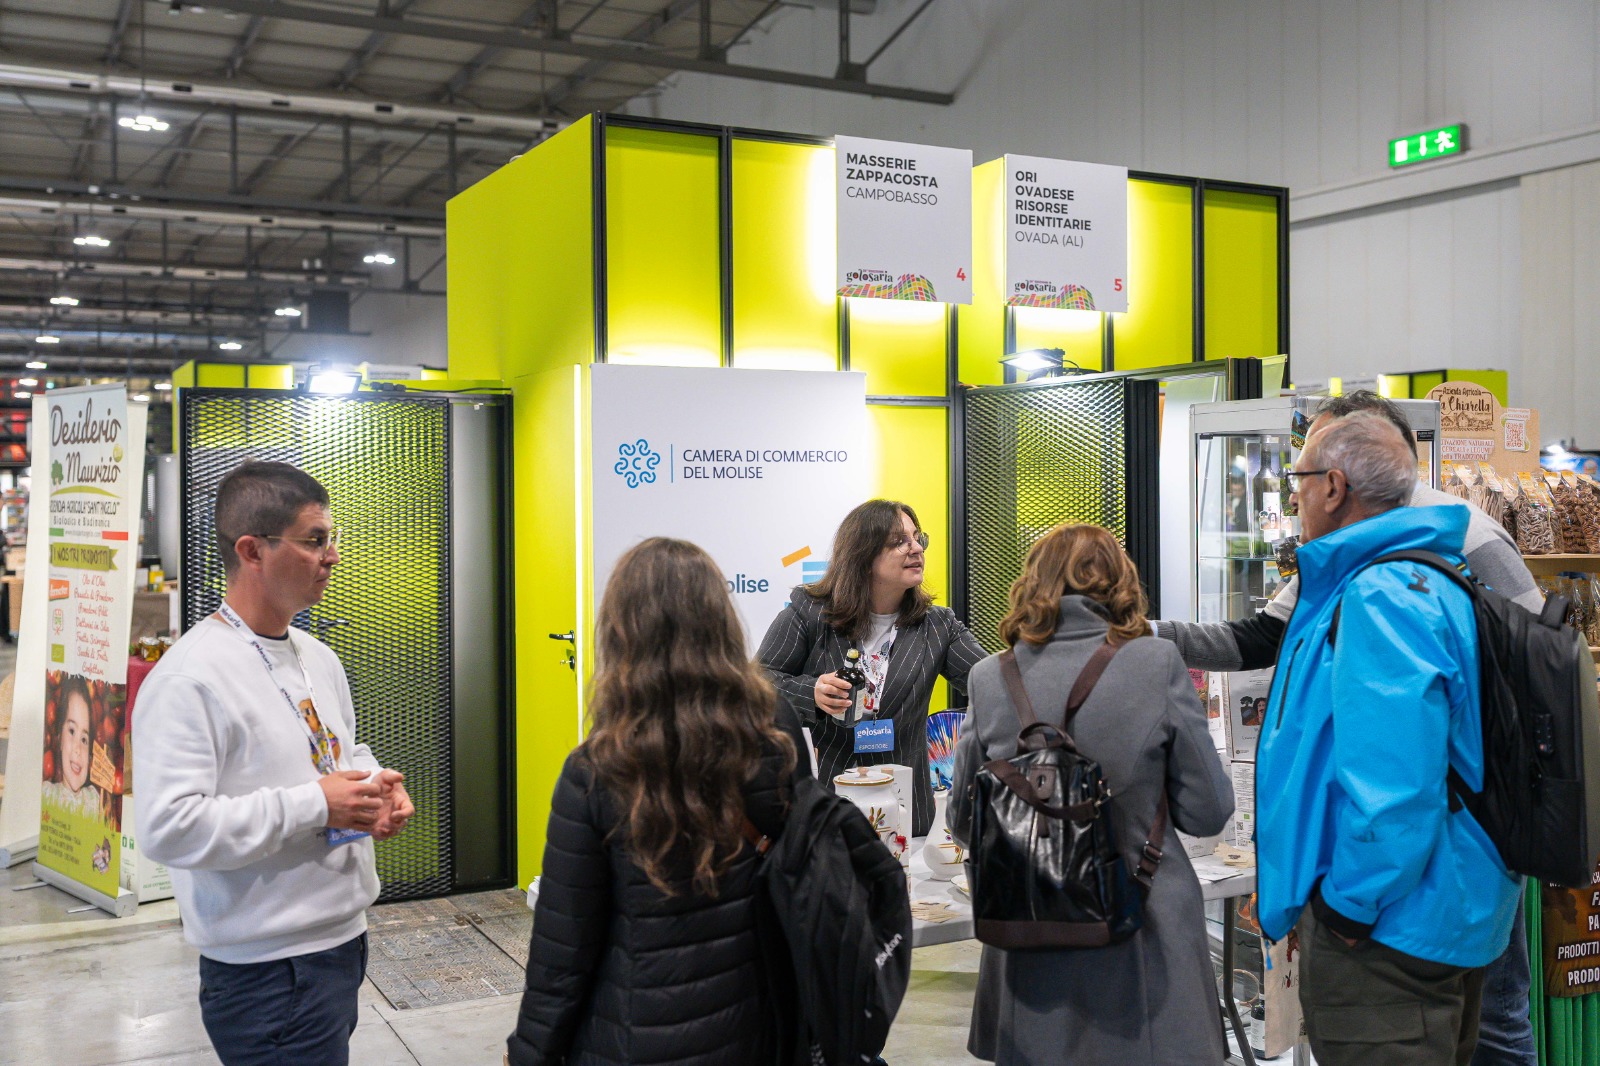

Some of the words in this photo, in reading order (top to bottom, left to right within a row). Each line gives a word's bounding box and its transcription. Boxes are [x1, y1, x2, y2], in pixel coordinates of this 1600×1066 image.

[846, 153, 916, 171] MASSERIE
[846, 168, 938, 189] ZAPPACOSTA
[1015, 170, 1037, 183] ORI
[846, 186, 938, 206] CAMPOBASSO
[1015, 185, 1074, 201] OVADESE
[1015, 200, 1068, 214] RISORSE
[1015, 214, 1091, 231] IDENTITARIE
[1015, 231, 1058, 245] OVADA
[1062, 234, 1084, 248] (AL)
[846, 268, 893, 282] golosaria
[956, 267, 967, 282] 4
[1014, 279, 1057, 292] golosaria
[1114, 278, 1122, 291] 5
[1449, 396, 1490, 412] Chiarella
[51, 397, 121, 447] Desiderio
[683, 449, 742, 463] CAMERA
[746, 450, 759, 463] DI
[762, 450, 848, 463] COMMERCIO
[66, 451, 121, 483] Maurizio
[684, 466, 710, 479] DEL
[713, 466, 763, 479] MOLISE
[727, 574, 768, 593] olise
[856, 725, 892, 739] golosaria
[1557, 941, 1600, 960] PRODOTTI
[1567, 966, 1600, 986] PRODO
